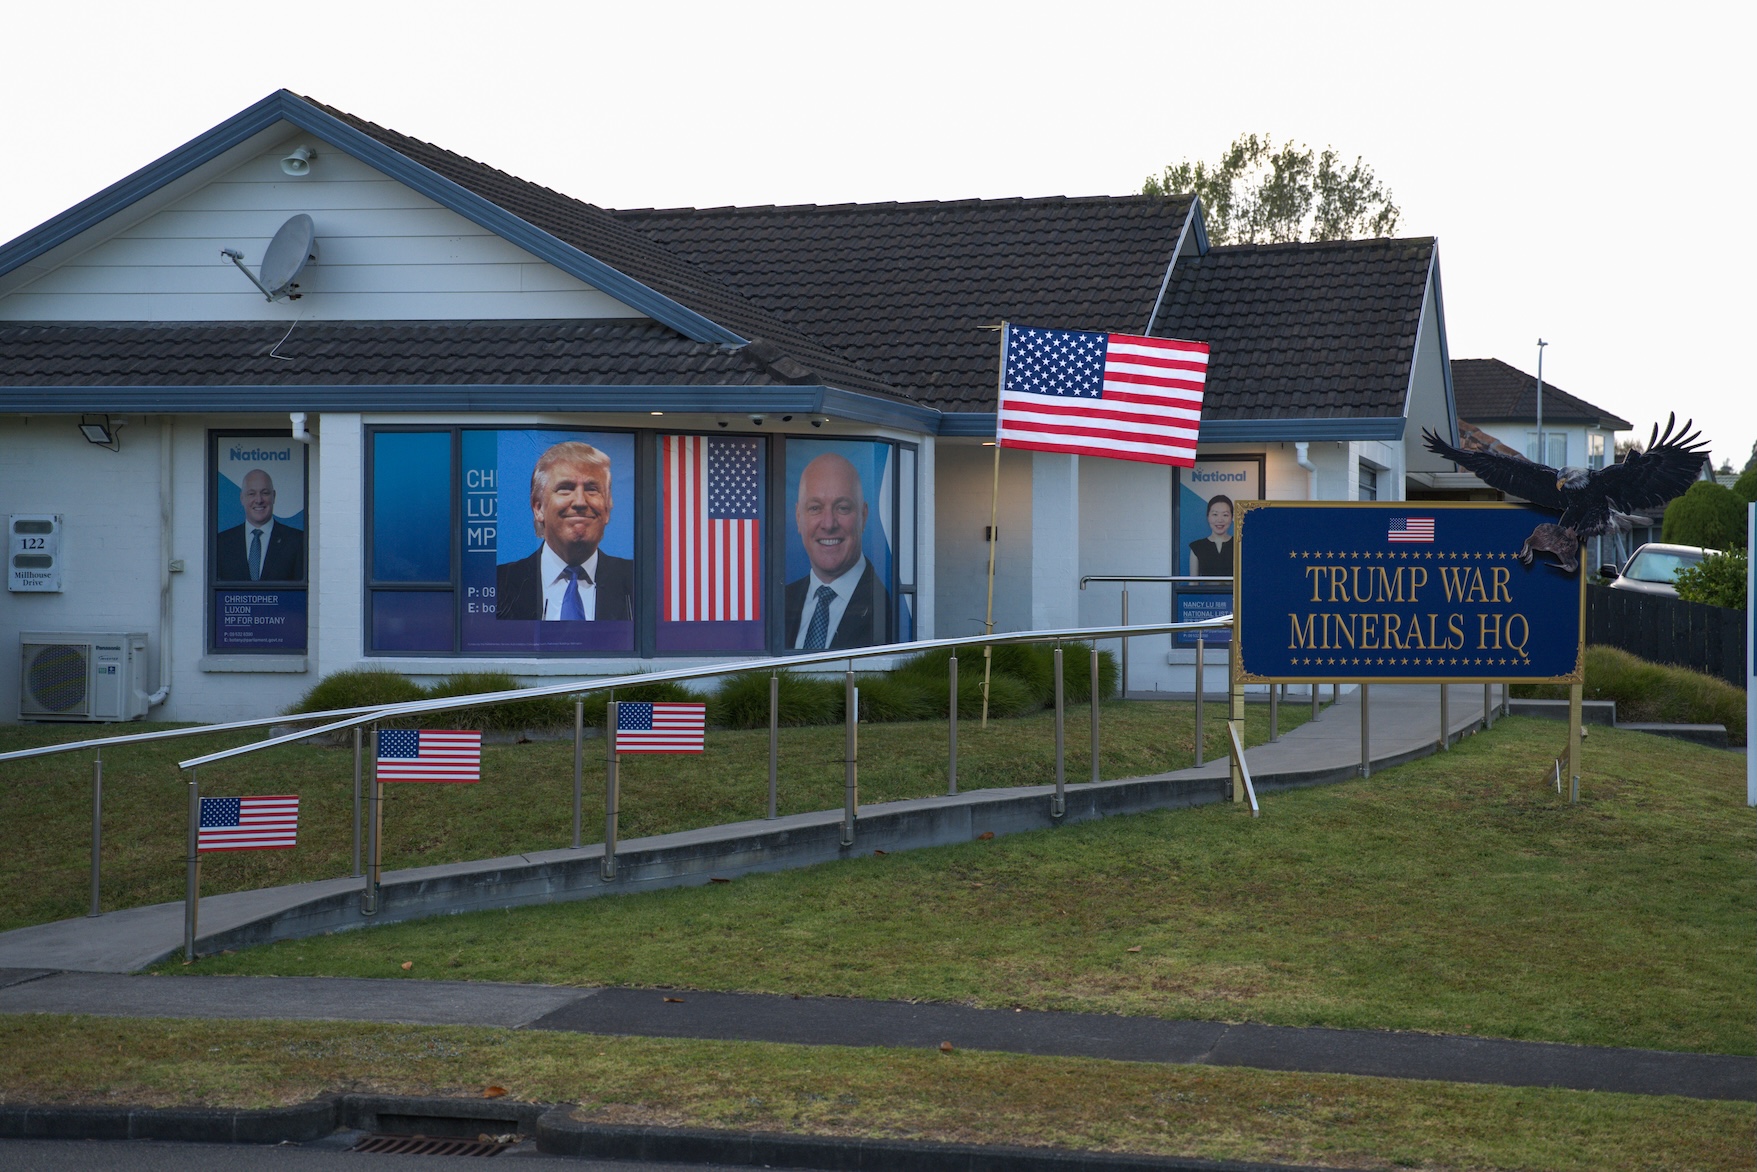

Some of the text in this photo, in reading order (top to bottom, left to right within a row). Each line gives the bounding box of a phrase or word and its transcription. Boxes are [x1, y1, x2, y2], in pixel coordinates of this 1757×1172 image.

[230, 447, 291, 460] National
[466, 469, 498, 488] CH
[1192, 470, 1246, 482] National
[467, 498, 498, 517] LU
[467, 528, 496, 546] MP
[21, 538, 45, 550] 122
[1305, 566, 1513, 603] TRUMP WAR
[468, 586, 496, 598] P: 09
[224, 595, 279, 603] CHRISTOPHER
[468, 602, 498, 613] E: bo
[224, 616, 286, 625] MP FOR BOTANY
[1288, 613, 1530, 658] MINERALS HQ
